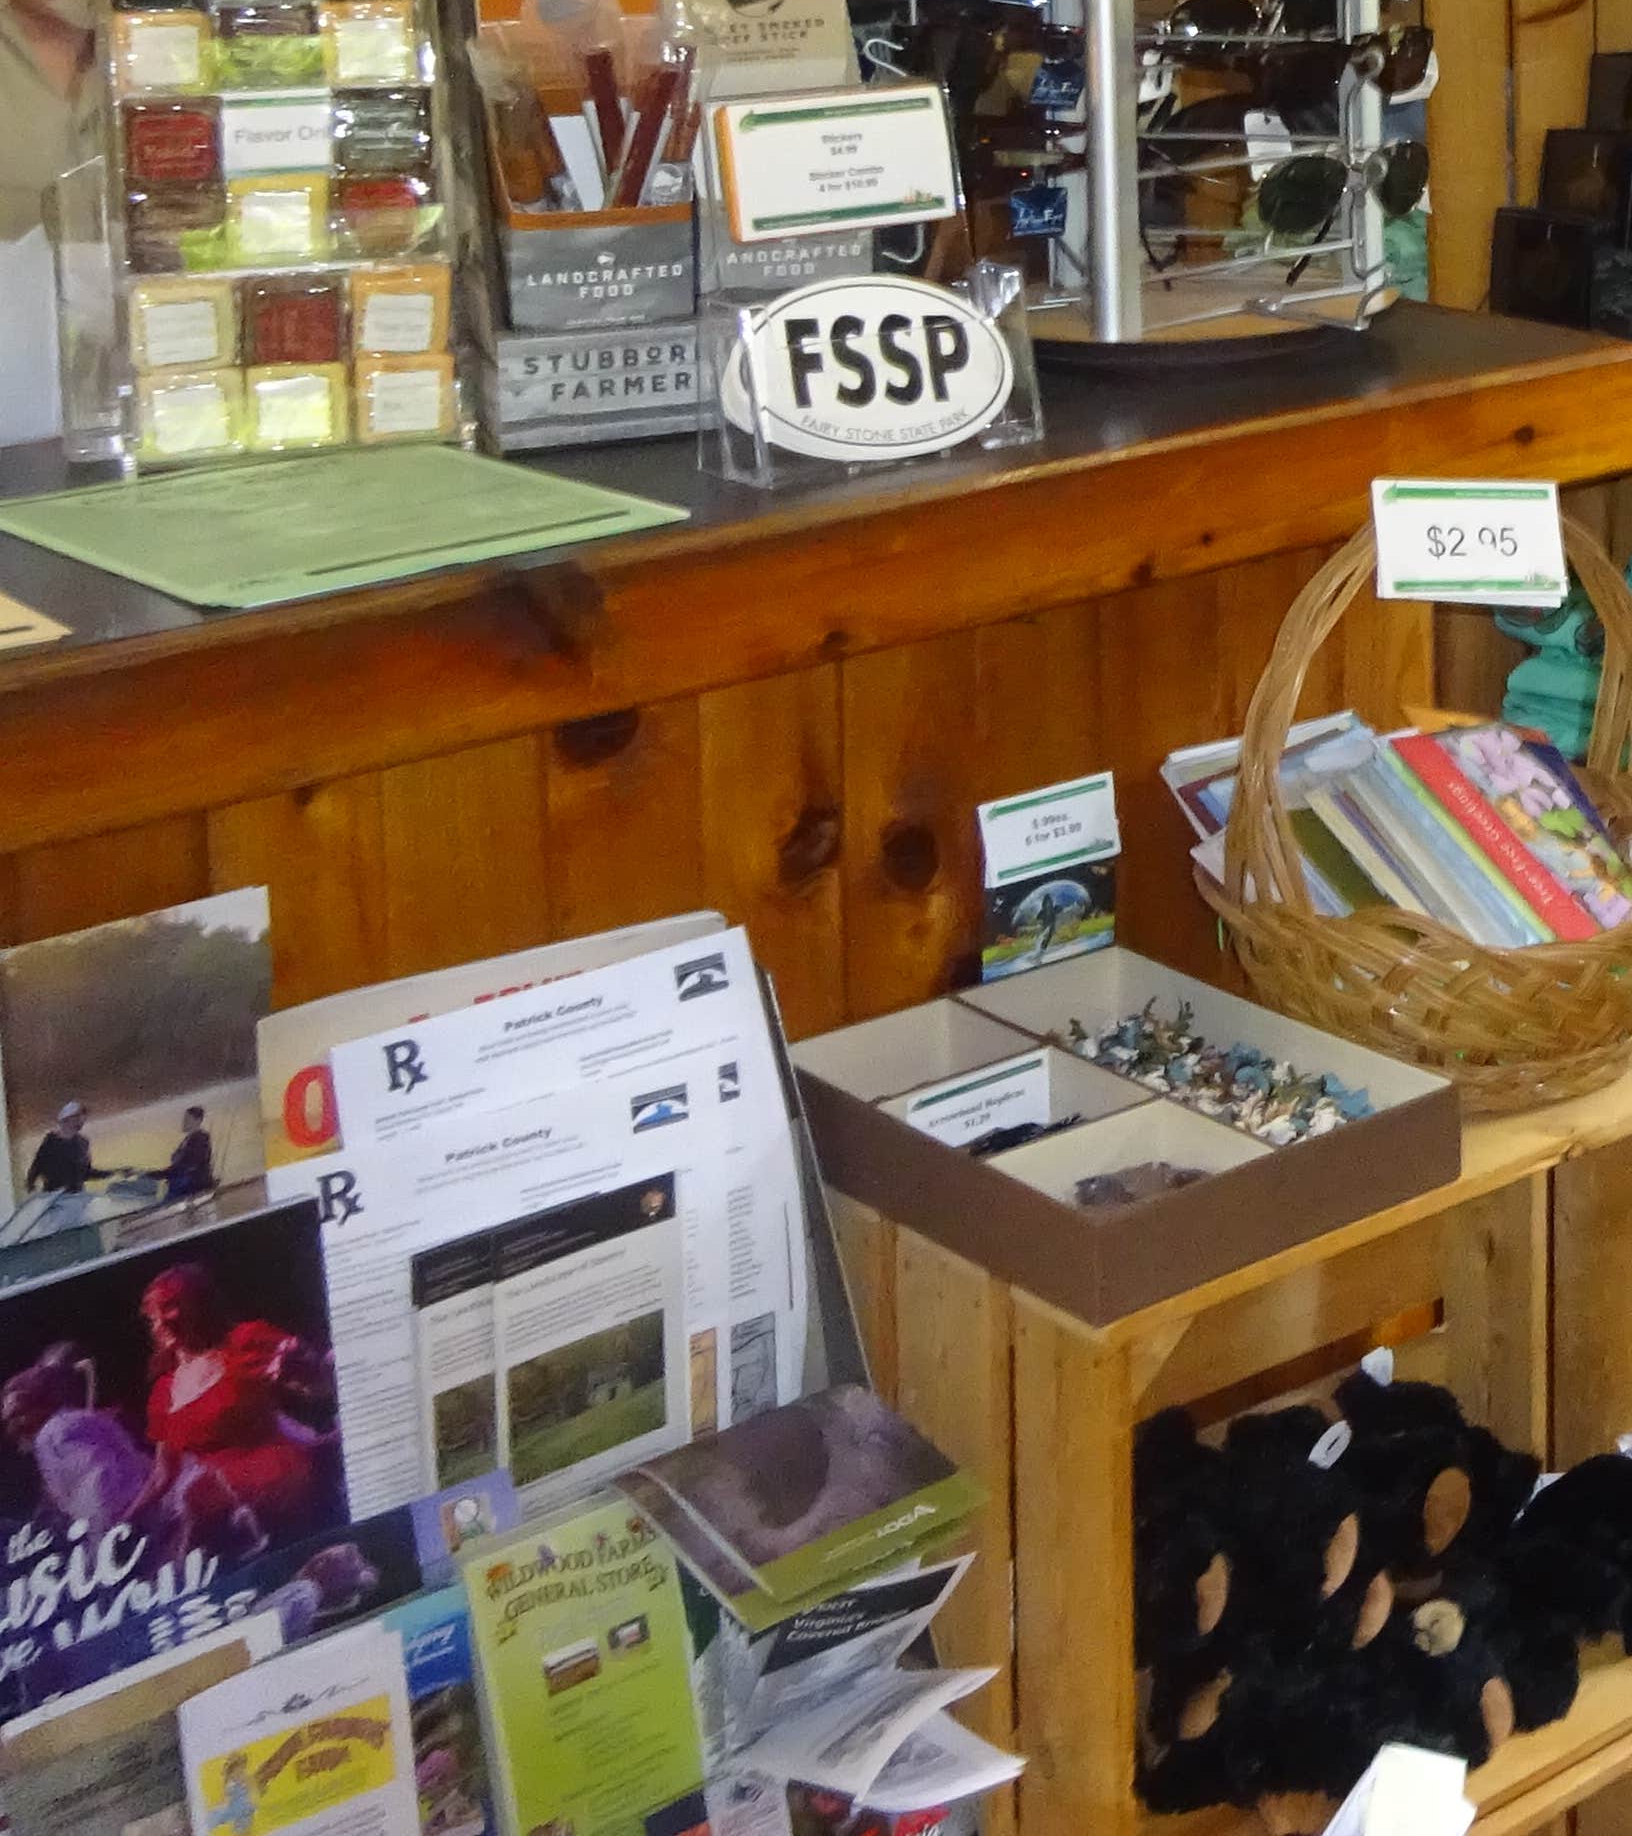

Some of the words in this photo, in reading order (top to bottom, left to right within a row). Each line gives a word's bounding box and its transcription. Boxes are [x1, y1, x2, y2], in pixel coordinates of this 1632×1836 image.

[234, 127, 292, 145] Flavor
[726, 244, 862, 265] ANDCRAFTED
[527, 264, 683, 286] LANDCRAFTED
[763, 264, 815, 277] FOOD
[579, 283, 635, 299] FOOD
[523, 344, 702, 375] STUBBOR
[784, 314, 970, 408] FSSP
[551, 372, 691, 401] FARMER
[801, 415, 840, 438] FAIRY
[846, 427, 895, 442] STONE
[900, 424, 935, 440] STATE
[939, 408, 970, 430] PARK
[504, 1010, 553, 1032] Patrick
[556, 996, 604, 1016] County
[445, 1141, 498, 1162] Patrick
[502, 1127, 552, 1148] County
[505, 1576, 594, 1621] GENERAL
